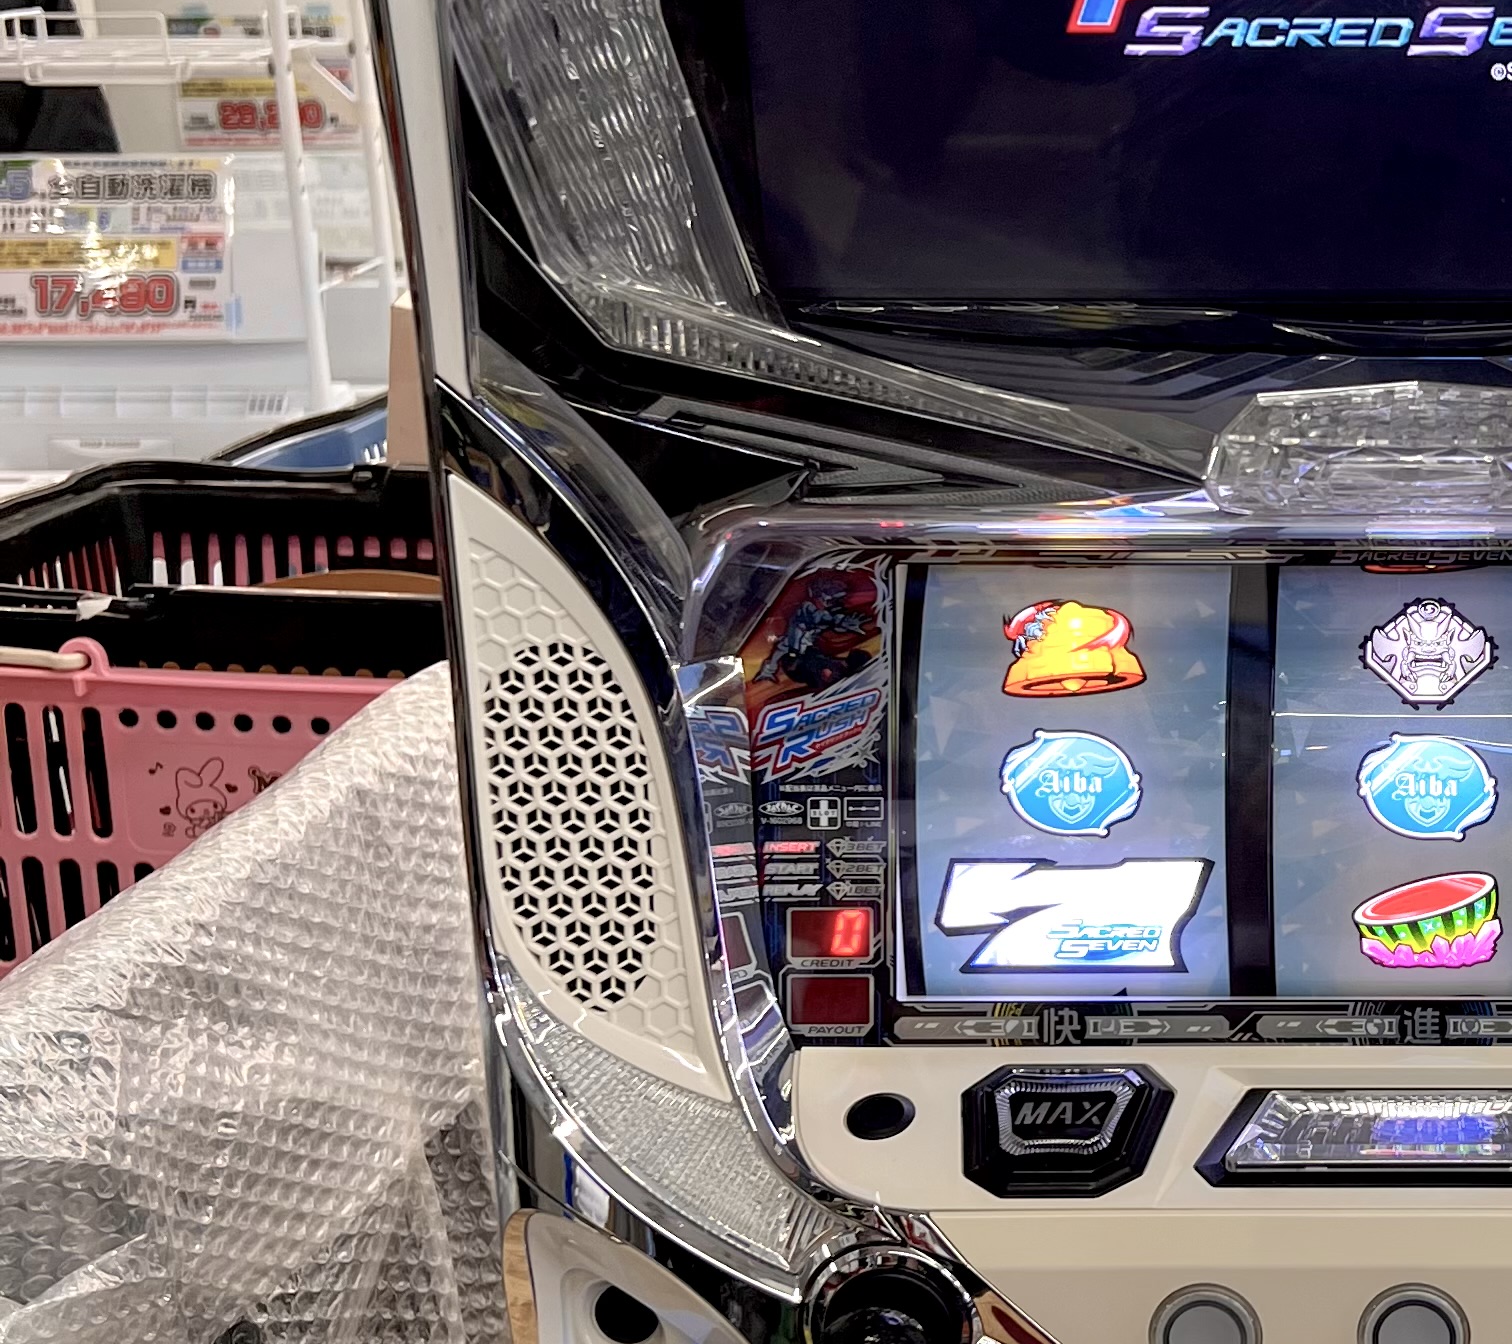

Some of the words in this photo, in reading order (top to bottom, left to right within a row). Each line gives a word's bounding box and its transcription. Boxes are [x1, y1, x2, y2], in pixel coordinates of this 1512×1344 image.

[1036, 769, 1103, 799] Aiba
[1391, 772, 1459, 802] Aiba
[766, 842, 817, 852] INSERT
[801, 959, 855, 968] CREDIT
[808, 1025, 865, 1035] PAYOUT
[1042, 1007, 1082, 1046] 快
[1403, 1008, 1442, 1045] 進
[1014, 1101, 1106, 1125] MAX
